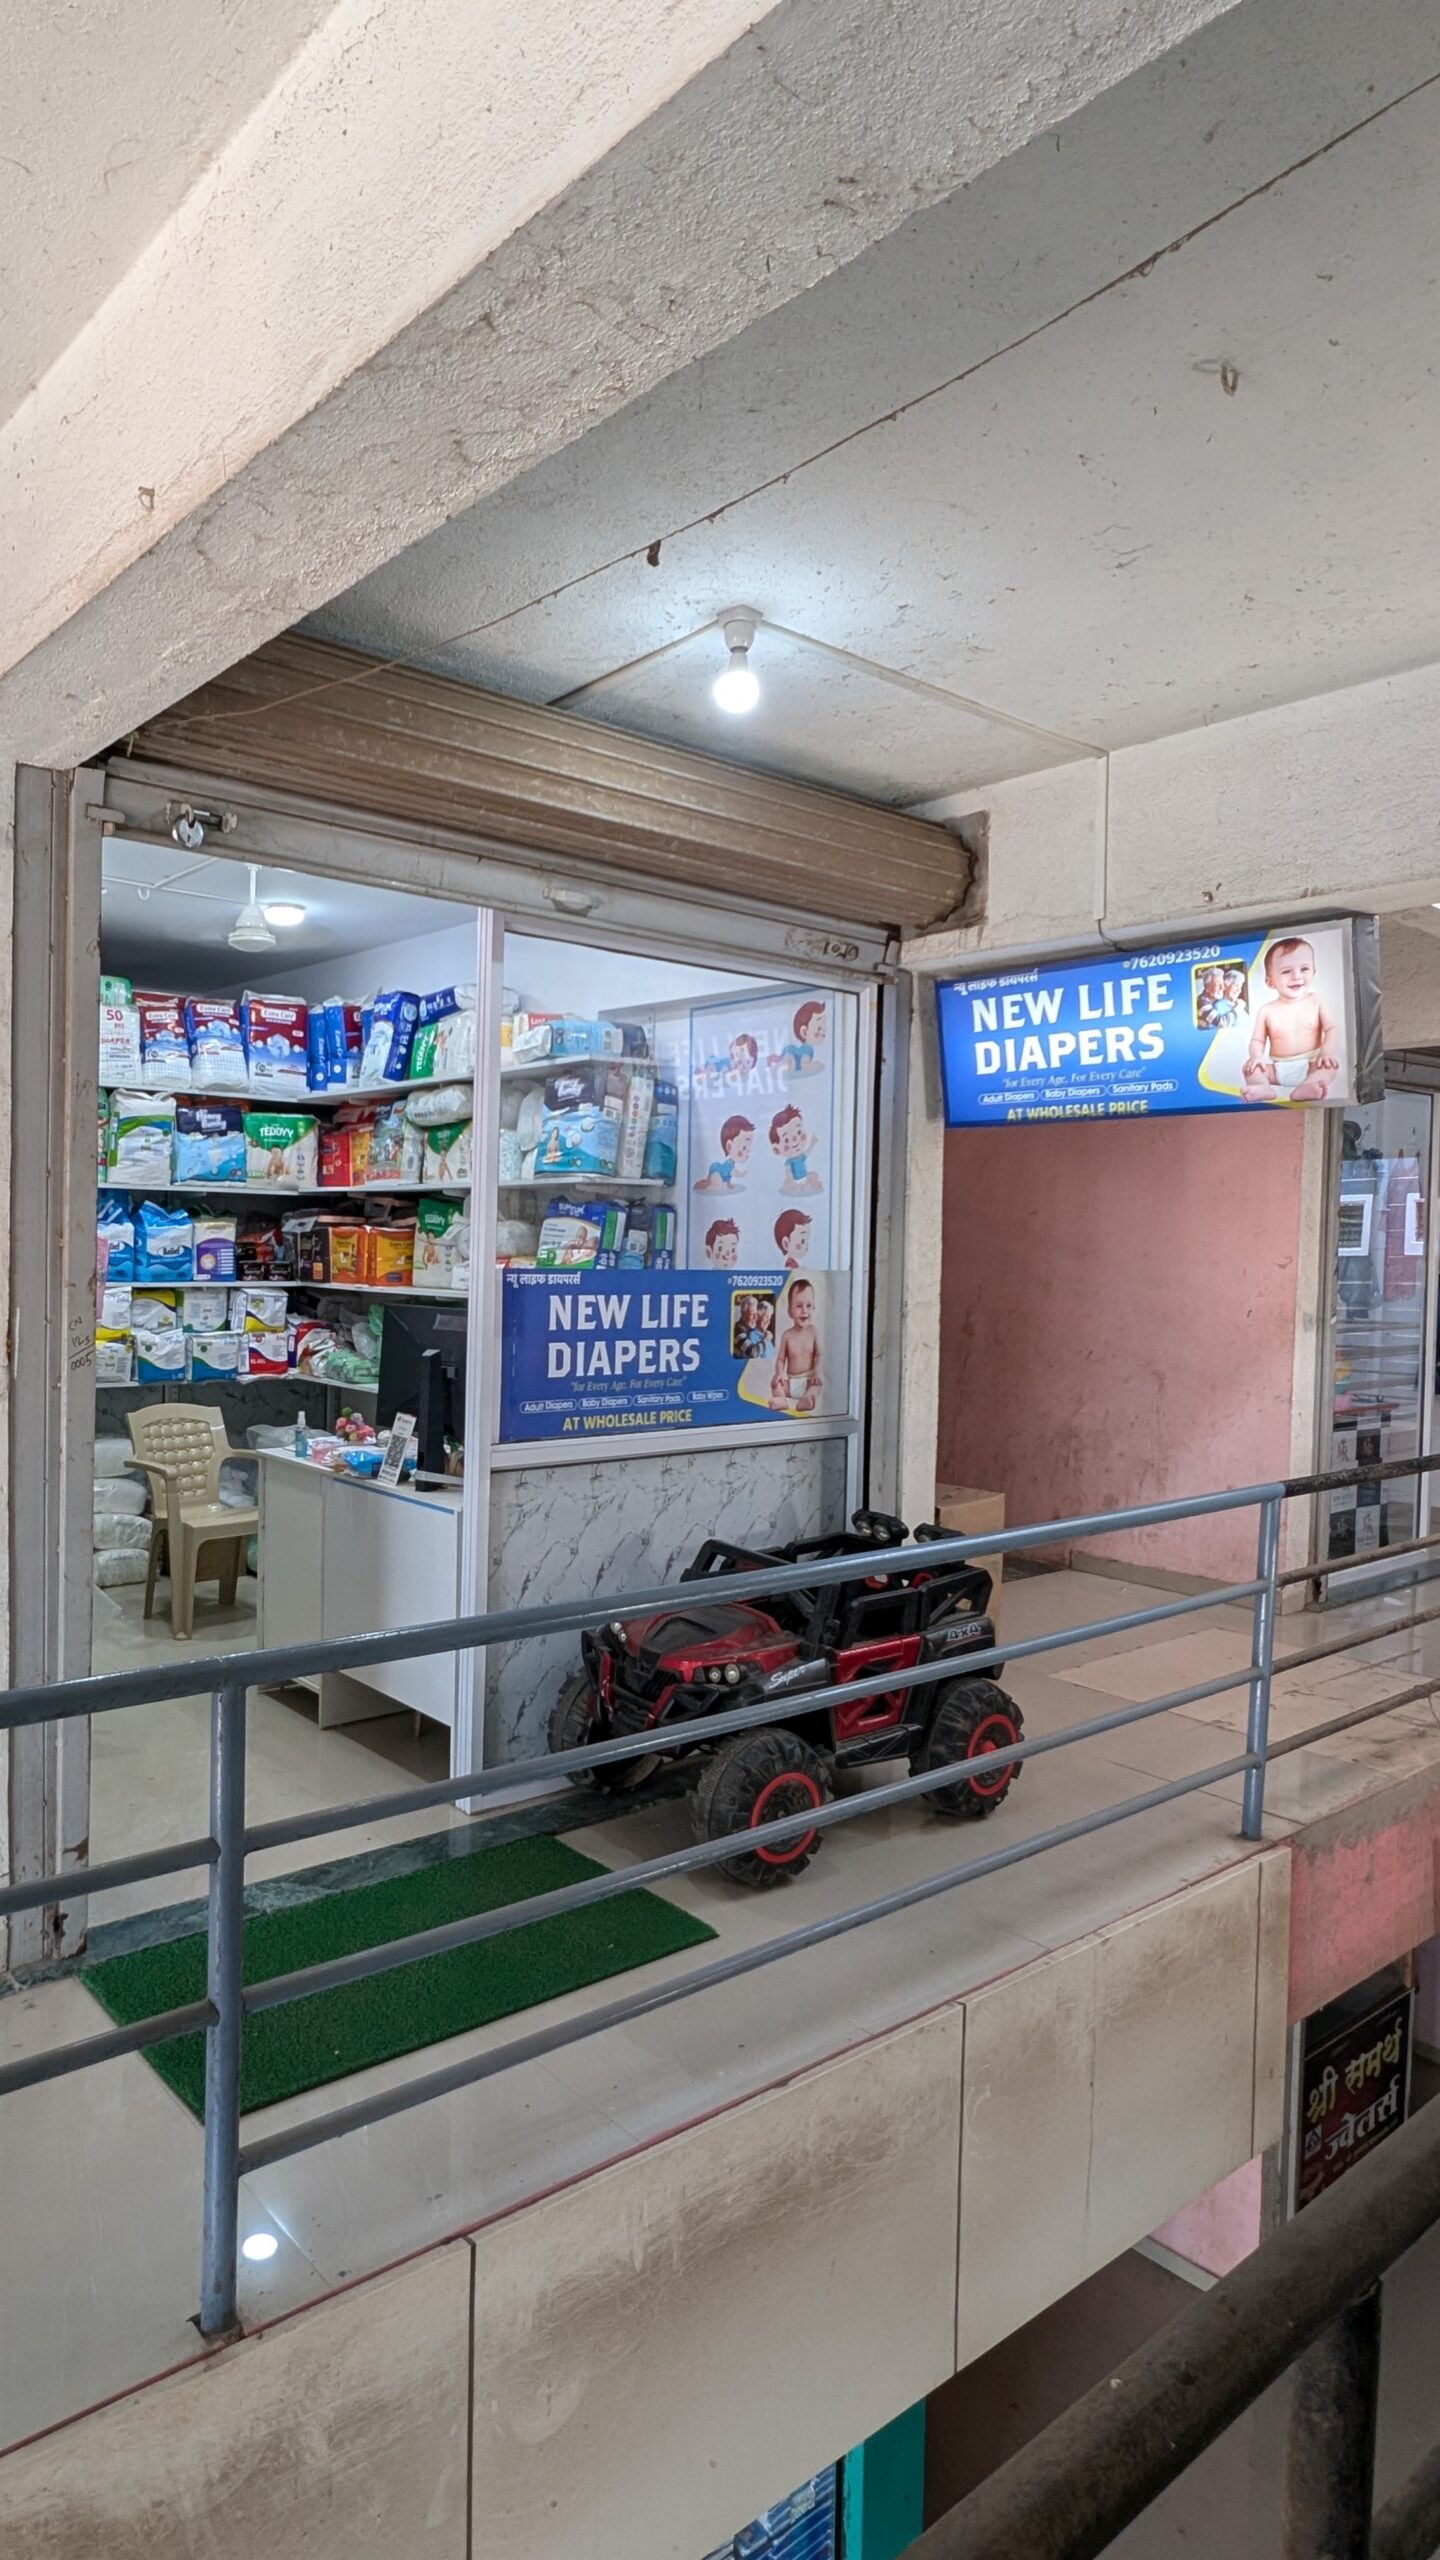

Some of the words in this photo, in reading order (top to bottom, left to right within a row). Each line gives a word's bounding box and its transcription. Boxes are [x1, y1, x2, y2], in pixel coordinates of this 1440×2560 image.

[1131, 945, 1221, 970] 7620923520
[972, 987, 1065, 1033] NEW
[1078, 973, 1174, 1021] LIFE
[975, 1022, 1165, 1076] DIAPERS
[1021, 1075, 1046, 1089] Every
[1071, 1072, 1086, 1083] For
[1089, 1070, 1114, 1085] Every
[1112, 1082, 1147, 1095] Sanitary
[1149, 1080, 1173, 1092] Pads
[983, 1094, 1004, 1104] Adult
[1005, 1091, 1035, 1103] Diapers
[1045, 1089, 1066, 1100] Baby
[1068, 1086, 1100, 1099] Diapers
[1007, 1108, 1022, 1122] AT
[1026, 1102, 1105, 1120] WHOLESALE
[1108, 1099, 1148, 1116] PRICE
[506, 1274, 519, 1288] न्यू
[520, 1273, 546, 1286] लाइफ
[547, 1271, 582, 1285] डायपरर्स
[731, 1275, 783, 1287] 7620923520
[548, 1294, 631, 1331] NEW
[641, 1294, 709, 1328] LIFE
[547, 1338, 701, 1378] DIAPERS
[586, 1381, 608, 1393] Every
[644, 1378, 665, 1390] Every
[545, 1401, 573, 1412] Diapers
[582, 1398, 601, 1409] Baby
[603, 1396, 628, 1408] Diapers
[637, 1394, 664, 1405] Sanitary
[562, 1416, 581, 1431] AT
[584, 1412, 657, 1430] WHOLESALE
[660, 1409, 692, 1423] PRICE
[768, 1665, 807, 1689] Super
[1306, 2065, 1339, 2123] श्री
[1345, 2016, 1402, 2094] समर्थ
